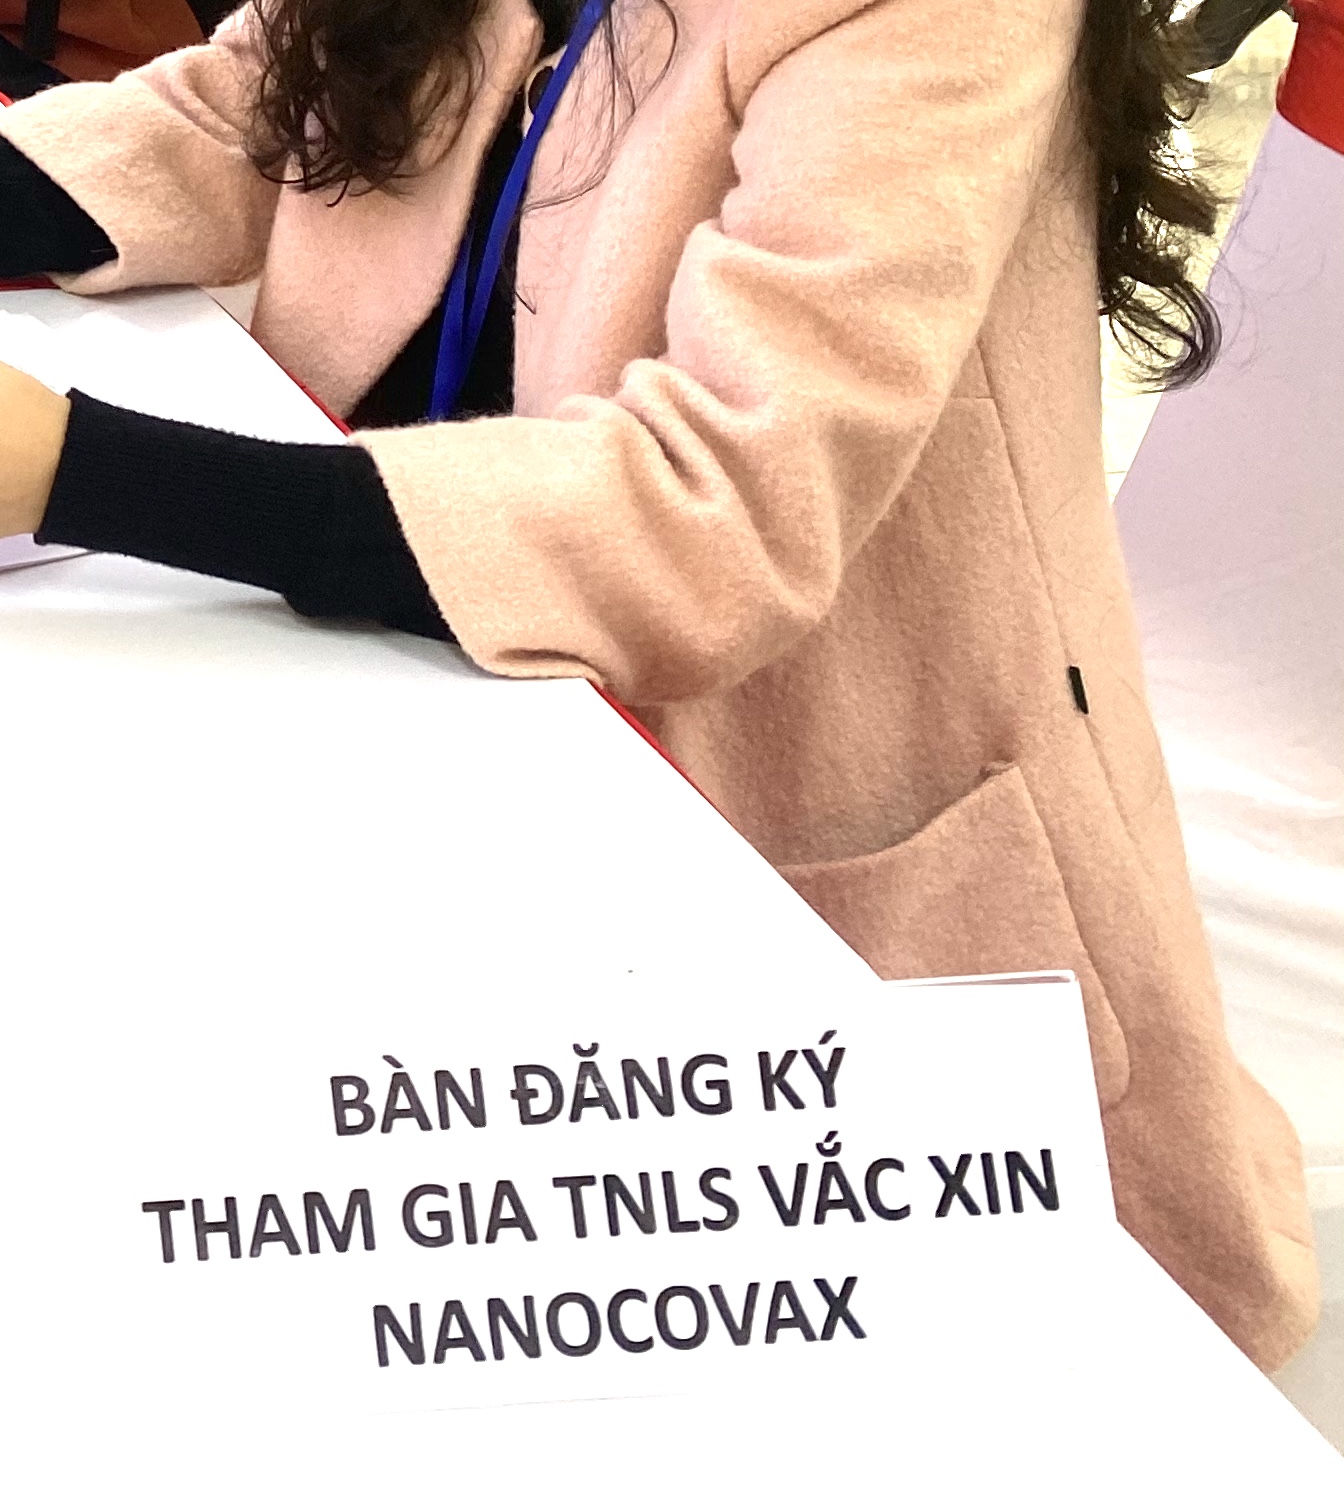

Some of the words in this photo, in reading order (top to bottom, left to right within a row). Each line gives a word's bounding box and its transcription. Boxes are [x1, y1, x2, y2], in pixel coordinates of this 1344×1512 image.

[330, 1055, 487, 1136] BÀN
[510, 1043, 733, 1125] ĐĂNG
[758, 1030, 846, 1112] KÝ
[142, 1189, 376, 1264] THAM
[402, 1179, 538, 1248] GIA
[551, 1167, 740, 1239] TNLS
[758, 1130, 911, 1227] VẮC
[927, 1149, 1060, 1219] XIN
[373, 1276, 867, 1368] NANOCOVAX
